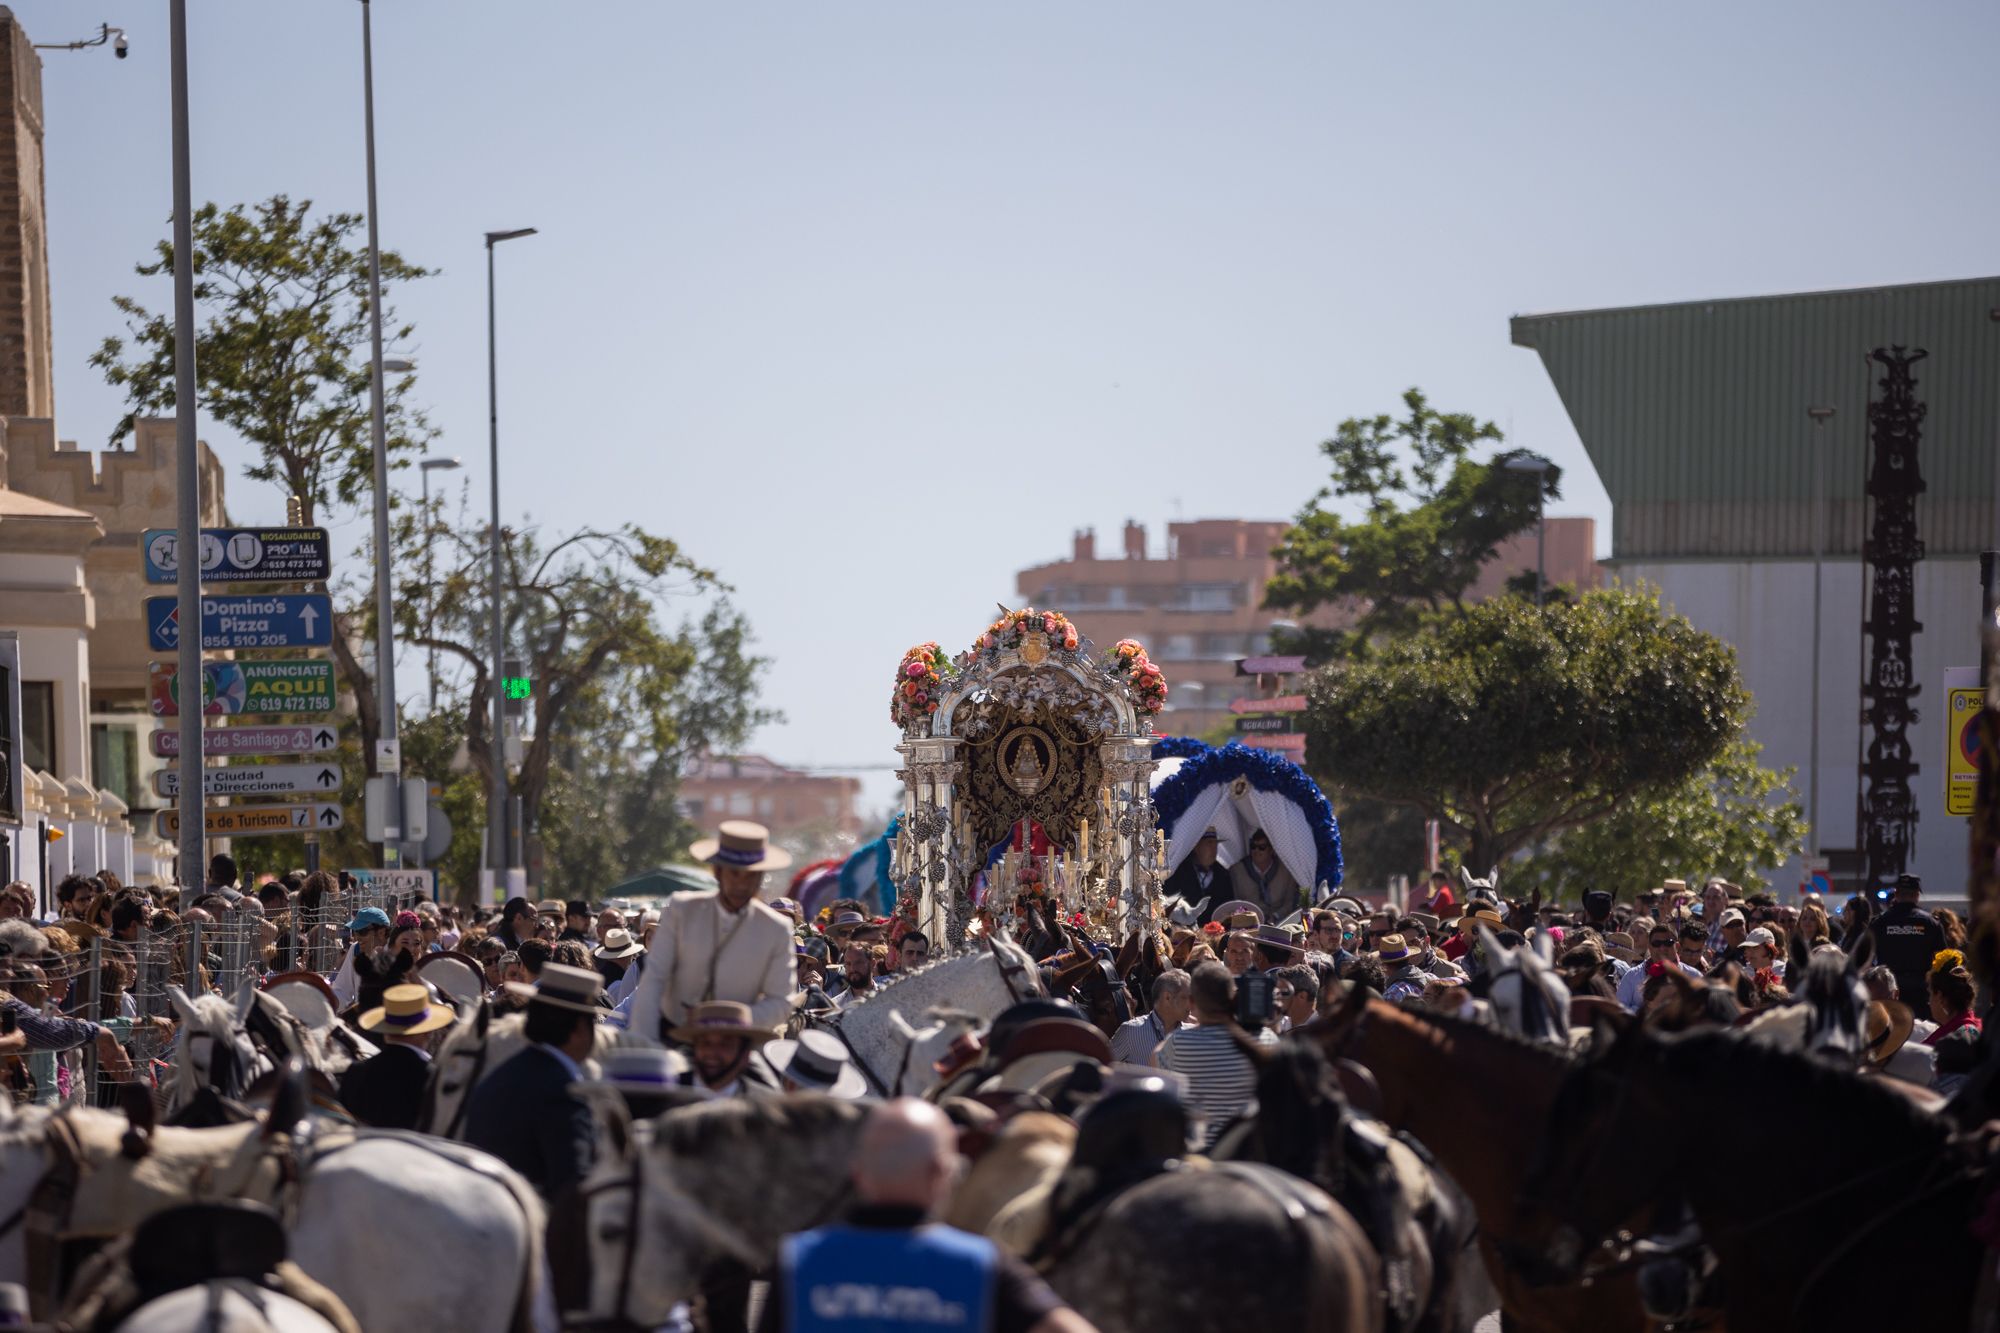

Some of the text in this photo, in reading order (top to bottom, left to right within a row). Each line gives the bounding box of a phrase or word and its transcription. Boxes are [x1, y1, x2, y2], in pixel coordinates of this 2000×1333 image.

[261, 532, 321, 541] BIOSALUDABLES
[269, 559, 323, 569] 619 472 758
[203, 598, 287, 615] Domino's
[220, 616, 269, 633] Pizza
[204, 634, 287, 647] 856 510 205
[246, 664, 329, 678] ANÚNCIATE
[249, 676, 326, 696] AQUÍ
[260, 696, 330, 711] 619 472 758
[213, 734, 229, 748] de
[232, 732, 288, 749] Santiago
[215, 771, 264, 782] Ciudad
[213, 782, 295, 793] Direcciones
[218, 816, 233, 828] de
[236, 814, 287, 828] Turismo
